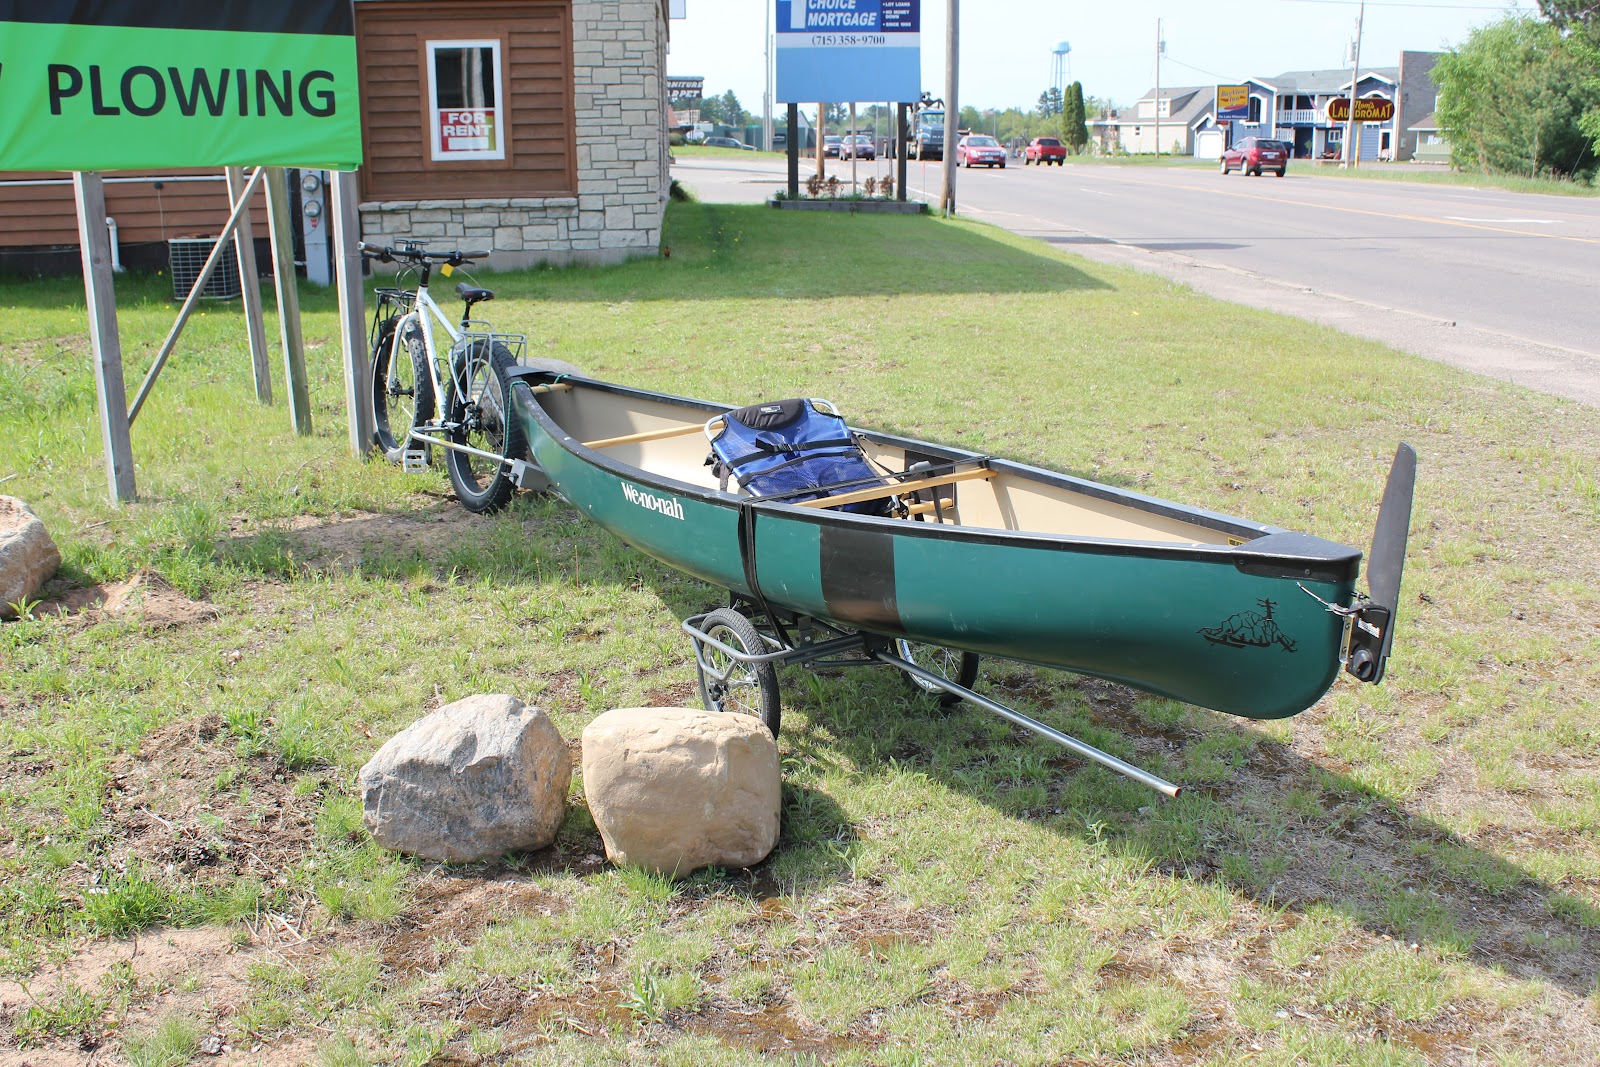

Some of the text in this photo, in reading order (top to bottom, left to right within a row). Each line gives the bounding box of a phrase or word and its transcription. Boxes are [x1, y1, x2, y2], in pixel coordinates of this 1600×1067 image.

[808, 0, 856, 9] CHOICE
[807, 12, 877, 26] MORTGAGE
[811, 35, 885, 46] (715) 358-9700
[47, 63, 336, 117] PLOWING
[1332, 103, 1392, 119] LAUDROMAT
[448, 112, 486, 124] FOR
[442, 125, 493, 137] RENT
